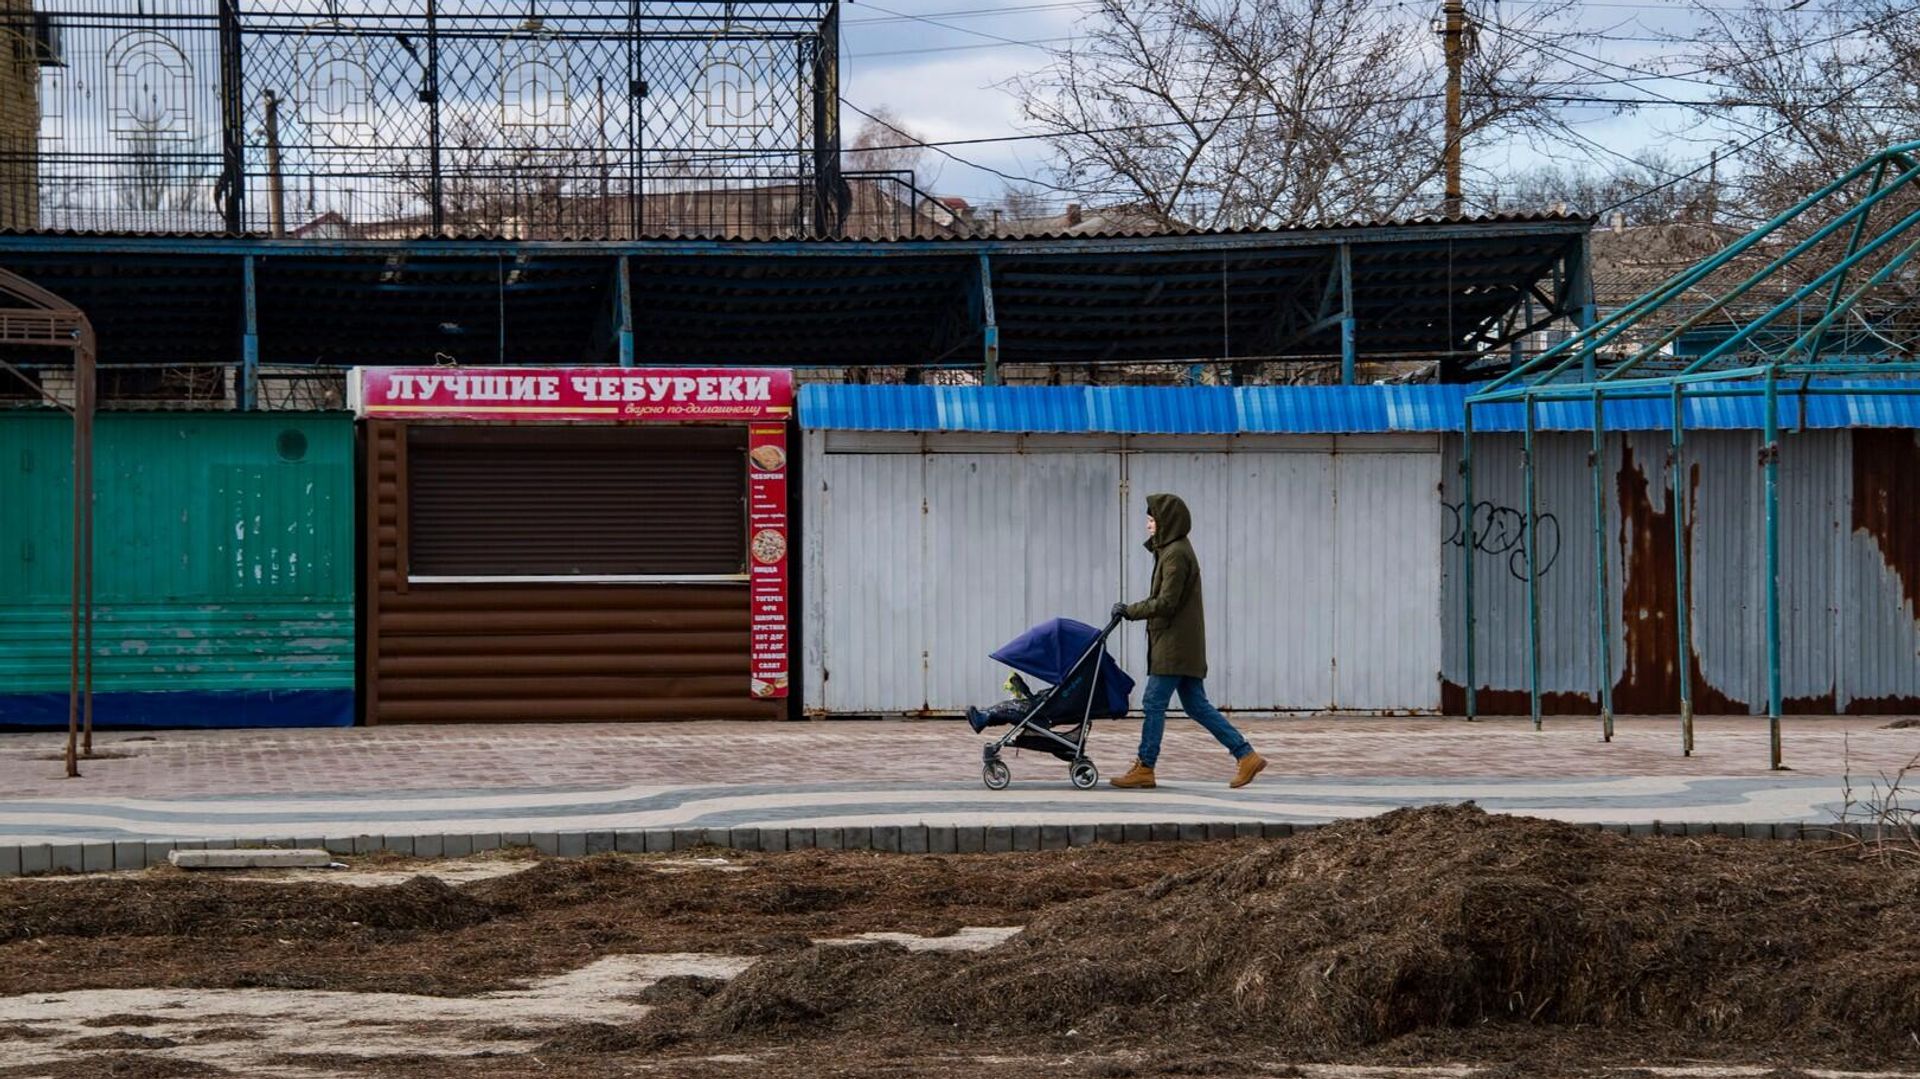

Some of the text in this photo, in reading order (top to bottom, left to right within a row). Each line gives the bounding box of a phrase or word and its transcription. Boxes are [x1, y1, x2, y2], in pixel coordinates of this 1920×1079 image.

[386, 375, 771, 401] ЛУЧШИЕ ЧЕБУРЕКИ
[624, 403, 762, 416] вкусно по-домашнему
